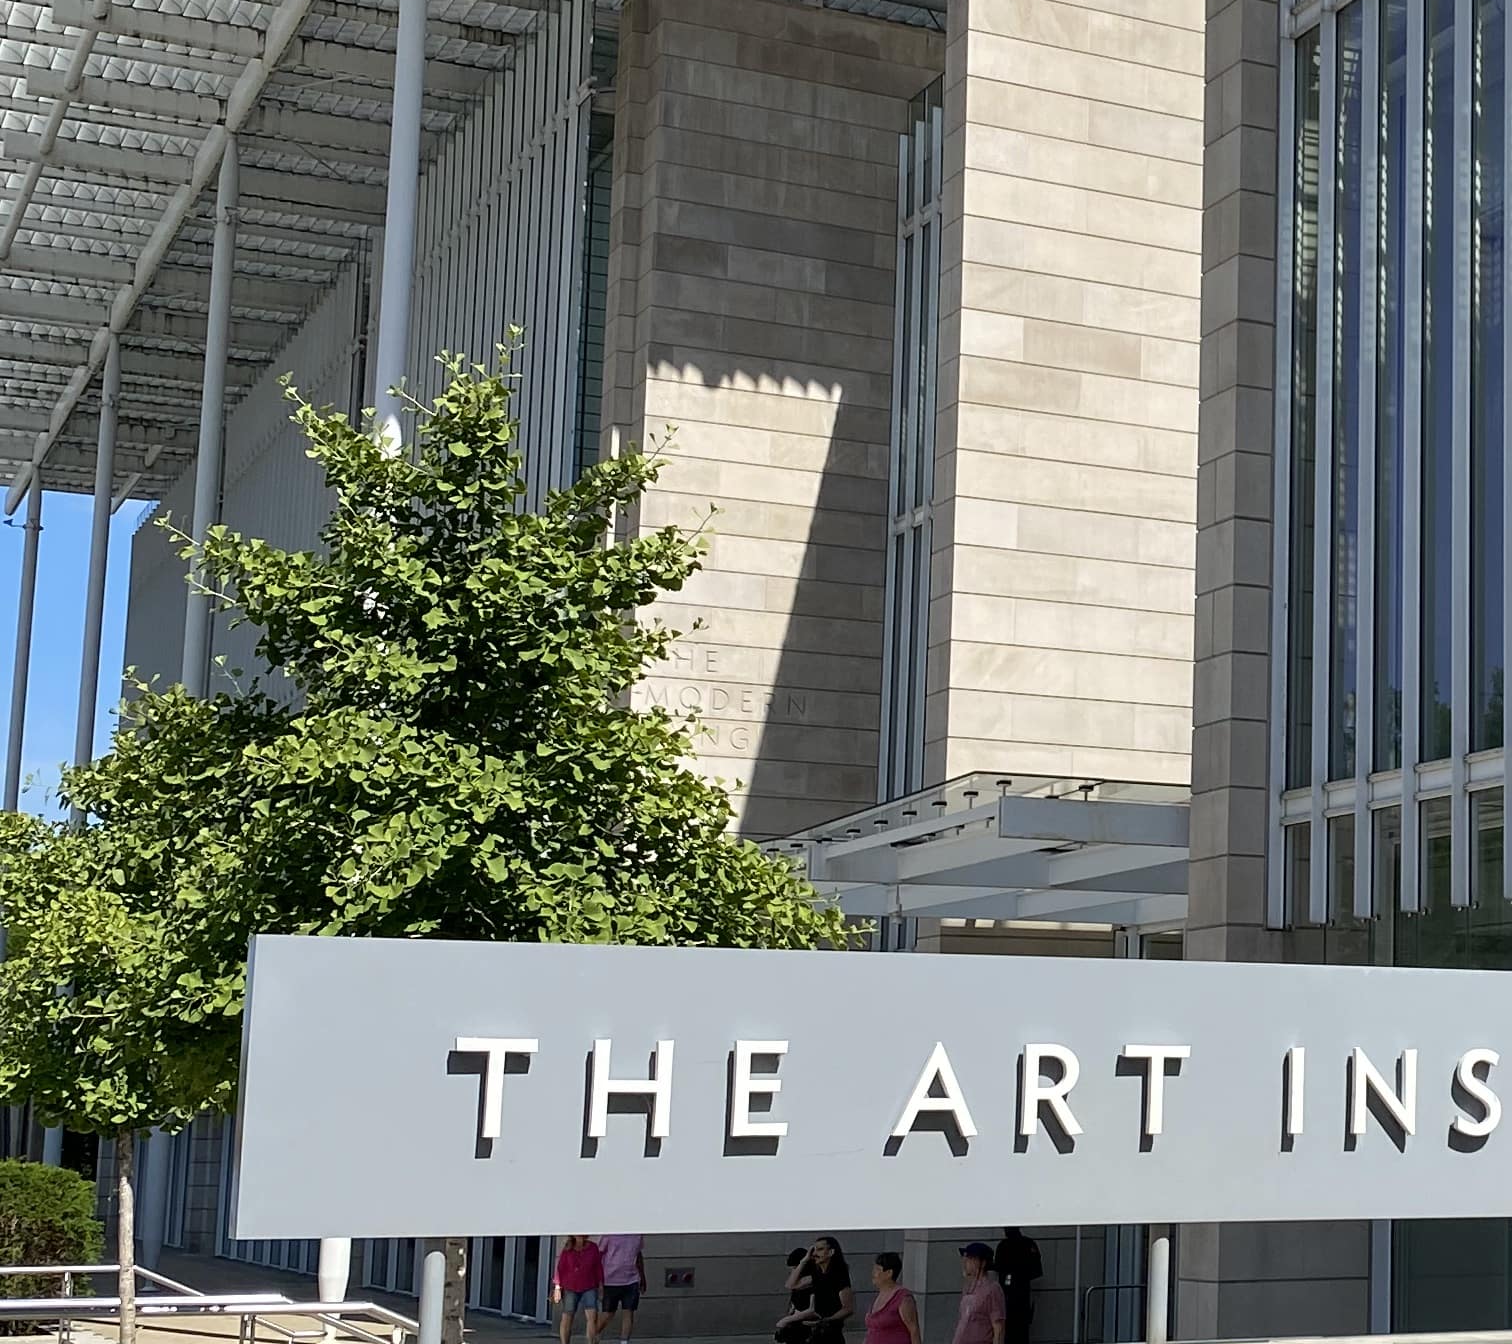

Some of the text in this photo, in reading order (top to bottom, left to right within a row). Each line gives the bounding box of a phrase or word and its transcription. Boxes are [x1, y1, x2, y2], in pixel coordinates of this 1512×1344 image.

[654, 646, 720, 673] HE
[643, 684, 808, 716] MODERN
[453, 1035, 790, 1141] THE
[889, 1040, 1192, 1139] ART
